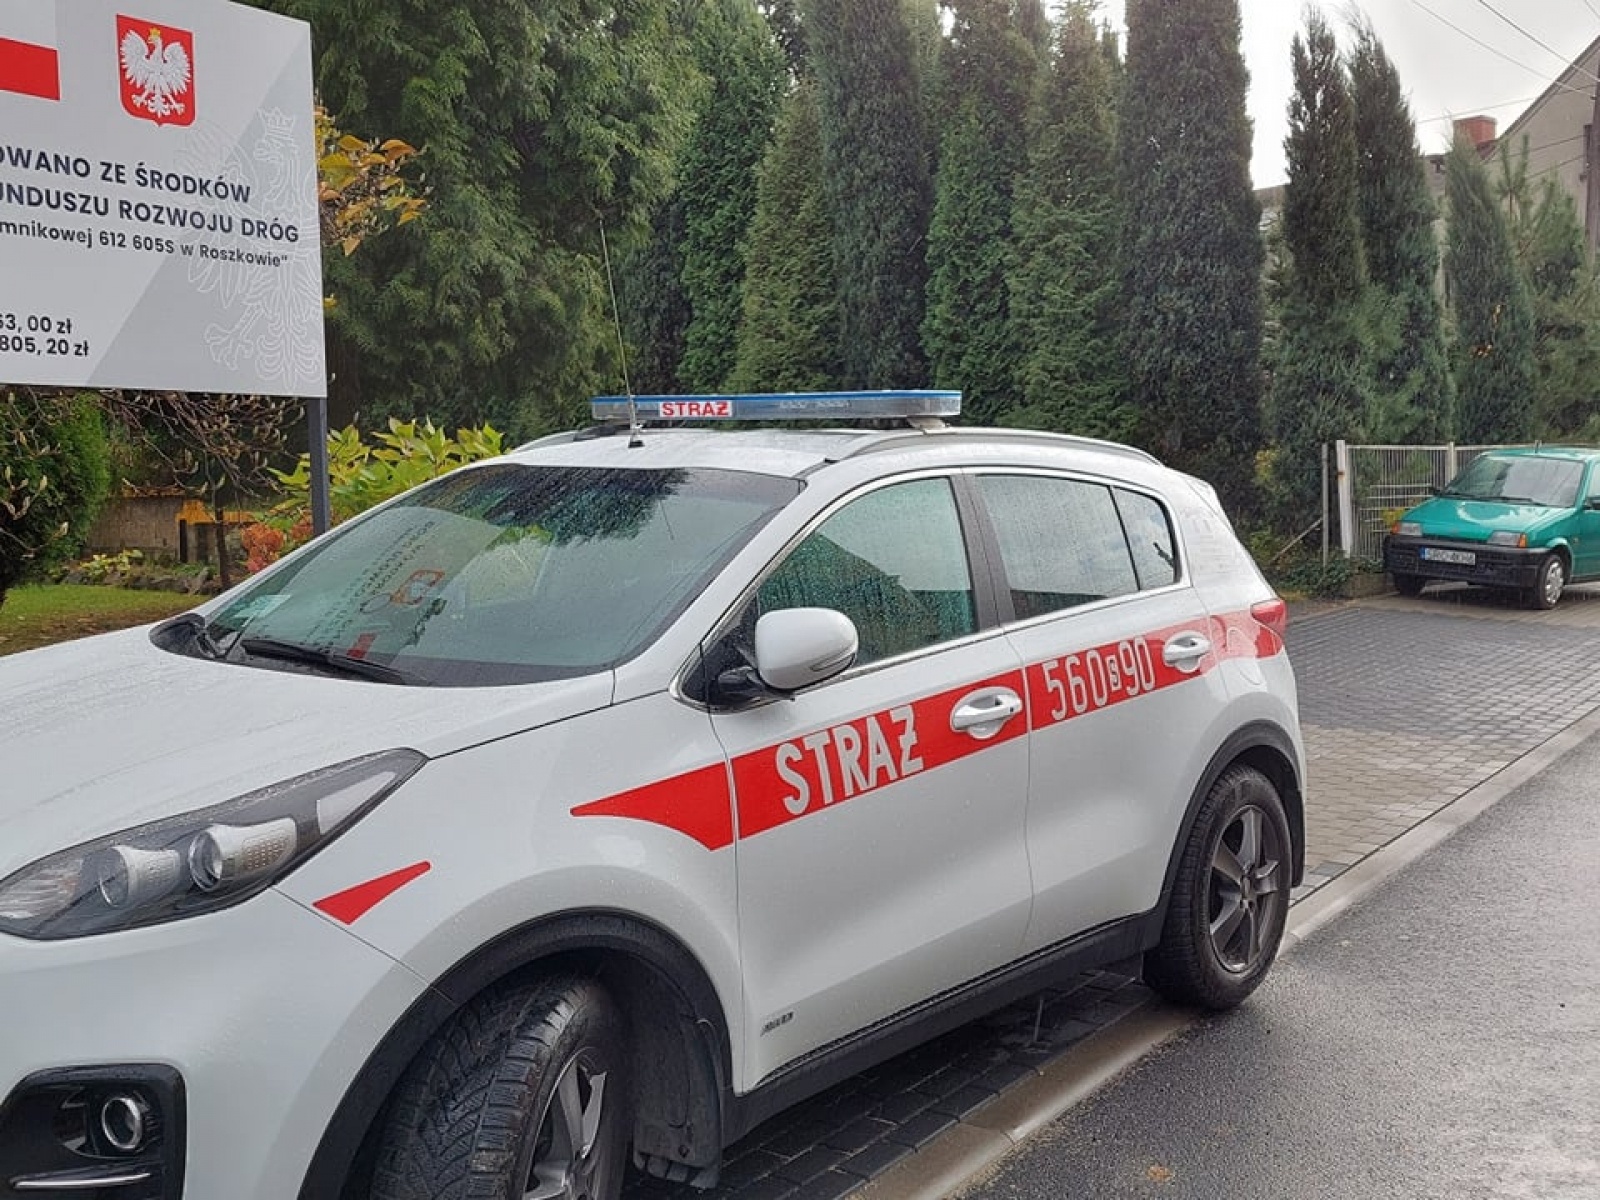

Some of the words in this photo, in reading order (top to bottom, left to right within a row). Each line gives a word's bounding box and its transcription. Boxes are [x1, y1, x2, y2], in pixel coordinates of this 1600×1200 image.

[0, 146, 91, 178] WANO
[100, 161, 126, 184] ZE
[134, 161, 250, 203] ŚRODKÓW
[0, 182, 109, 216] NDUSZU
[119, 199, 233, 234] ROZWOJU
[241, 217, 299, 243] DRÓG
[100, 230, 126, 248] 612
[133, 234, 174, 254] 605S
[180, 244, 194, 256] w
[0, 312, 21, 333] 3,
[28, 315, 51, 332] 00
[57, 317, 72, 334] zł
[46, 338, 69, 355] 20
[74, 339, 89, 357] zł
[661, 401, 729, 417] STRAŻ
[775, 704, 924, 815] STRAŻ
